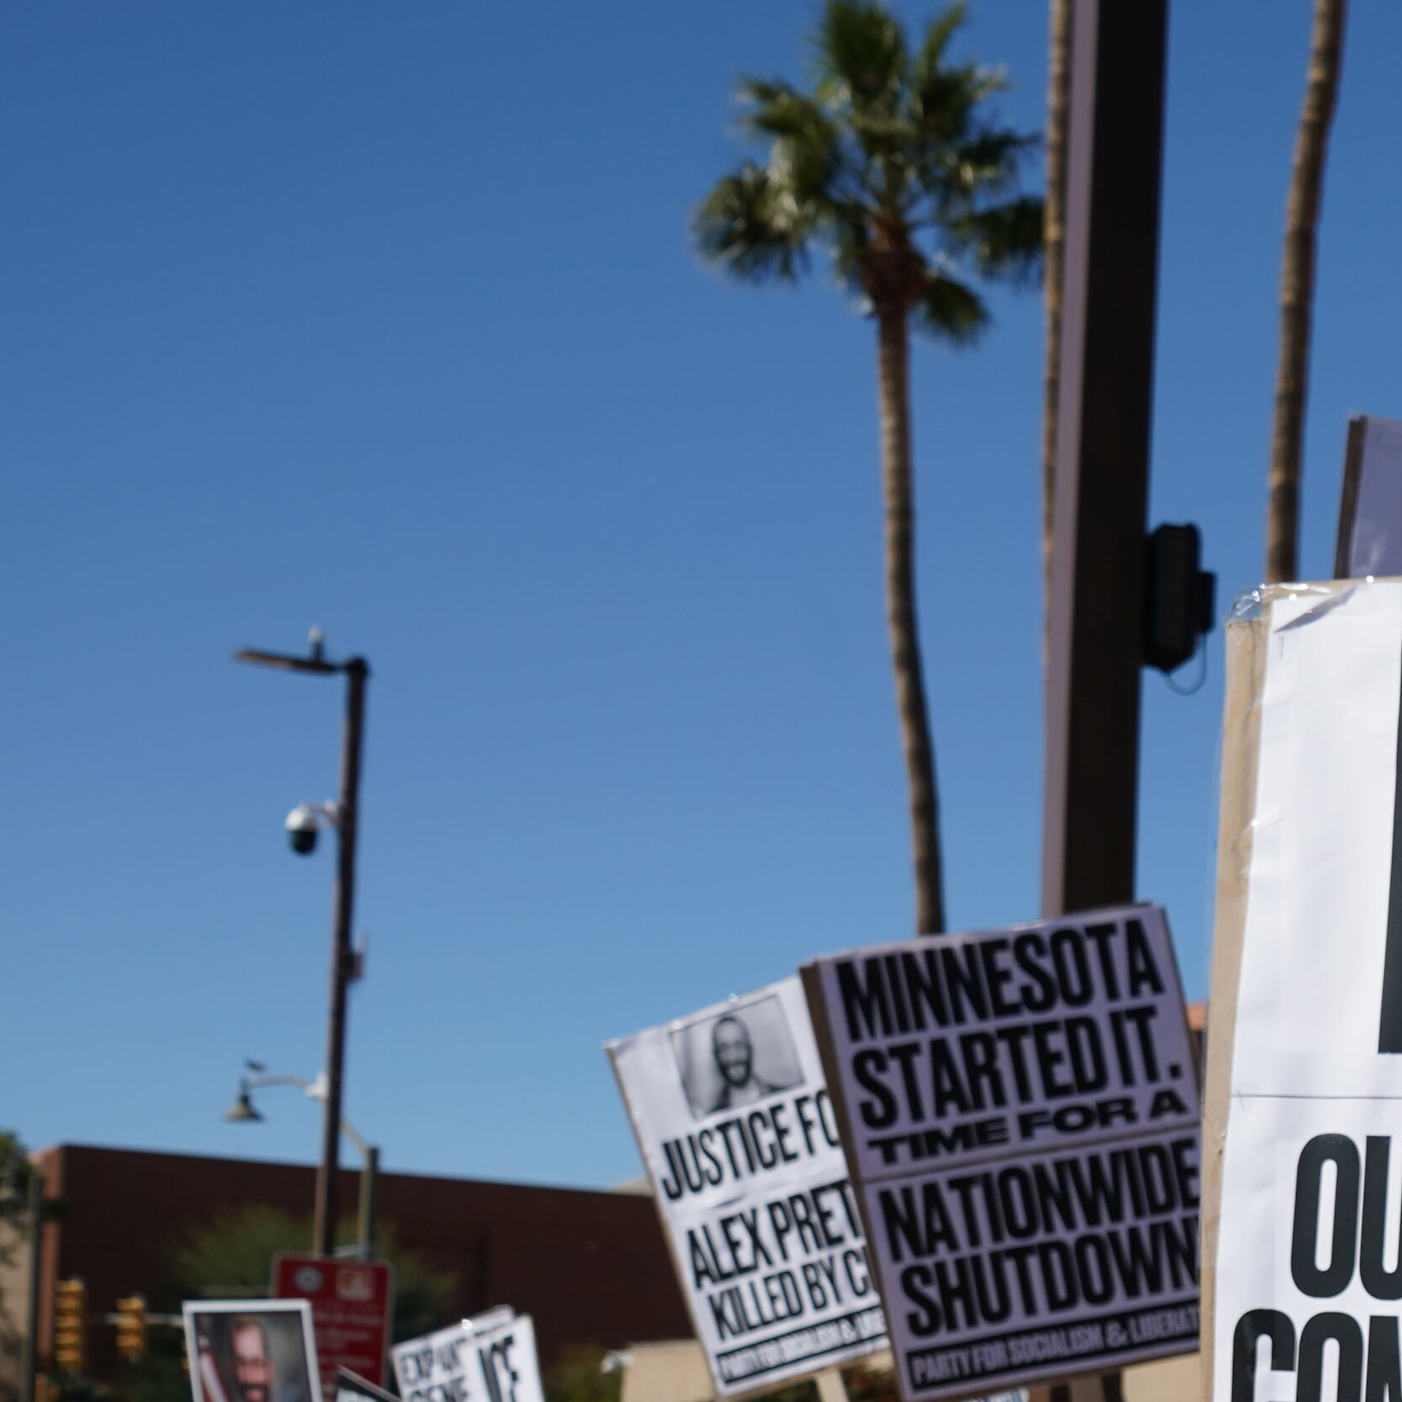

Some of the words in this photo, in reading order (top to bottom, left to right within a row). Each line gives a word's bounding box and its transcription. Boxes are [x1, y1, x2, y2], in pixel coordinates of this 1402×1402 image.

[834, 920, 1165, 1042] MINNESOTA
[851, 1015, 1106, 1131] STARTED
[1109, 1006, 1183, 1086] IT.
[661, 1107, 798, 1202] JUSTICE
[867, 1114, 1011, 1166] TIME
[1018, 1097, 1140, 1139] FOR
[1142, 1089, 1190, 1121] A
[686, 1197, 776, 1291] ALEX
[879, 1137, 1199, 1264] NATIONWIDE
[708, 1271, 803, 1341] KILLED
[802, 1254, 841, 1310] BY
[843, 1249, 874, 1300] C
[901, 1214, 1200, 1339] SHUTDOWN
[912, 1346, 971, 1385] PARTY
[972, 1340, 1009, 1375] FOR
